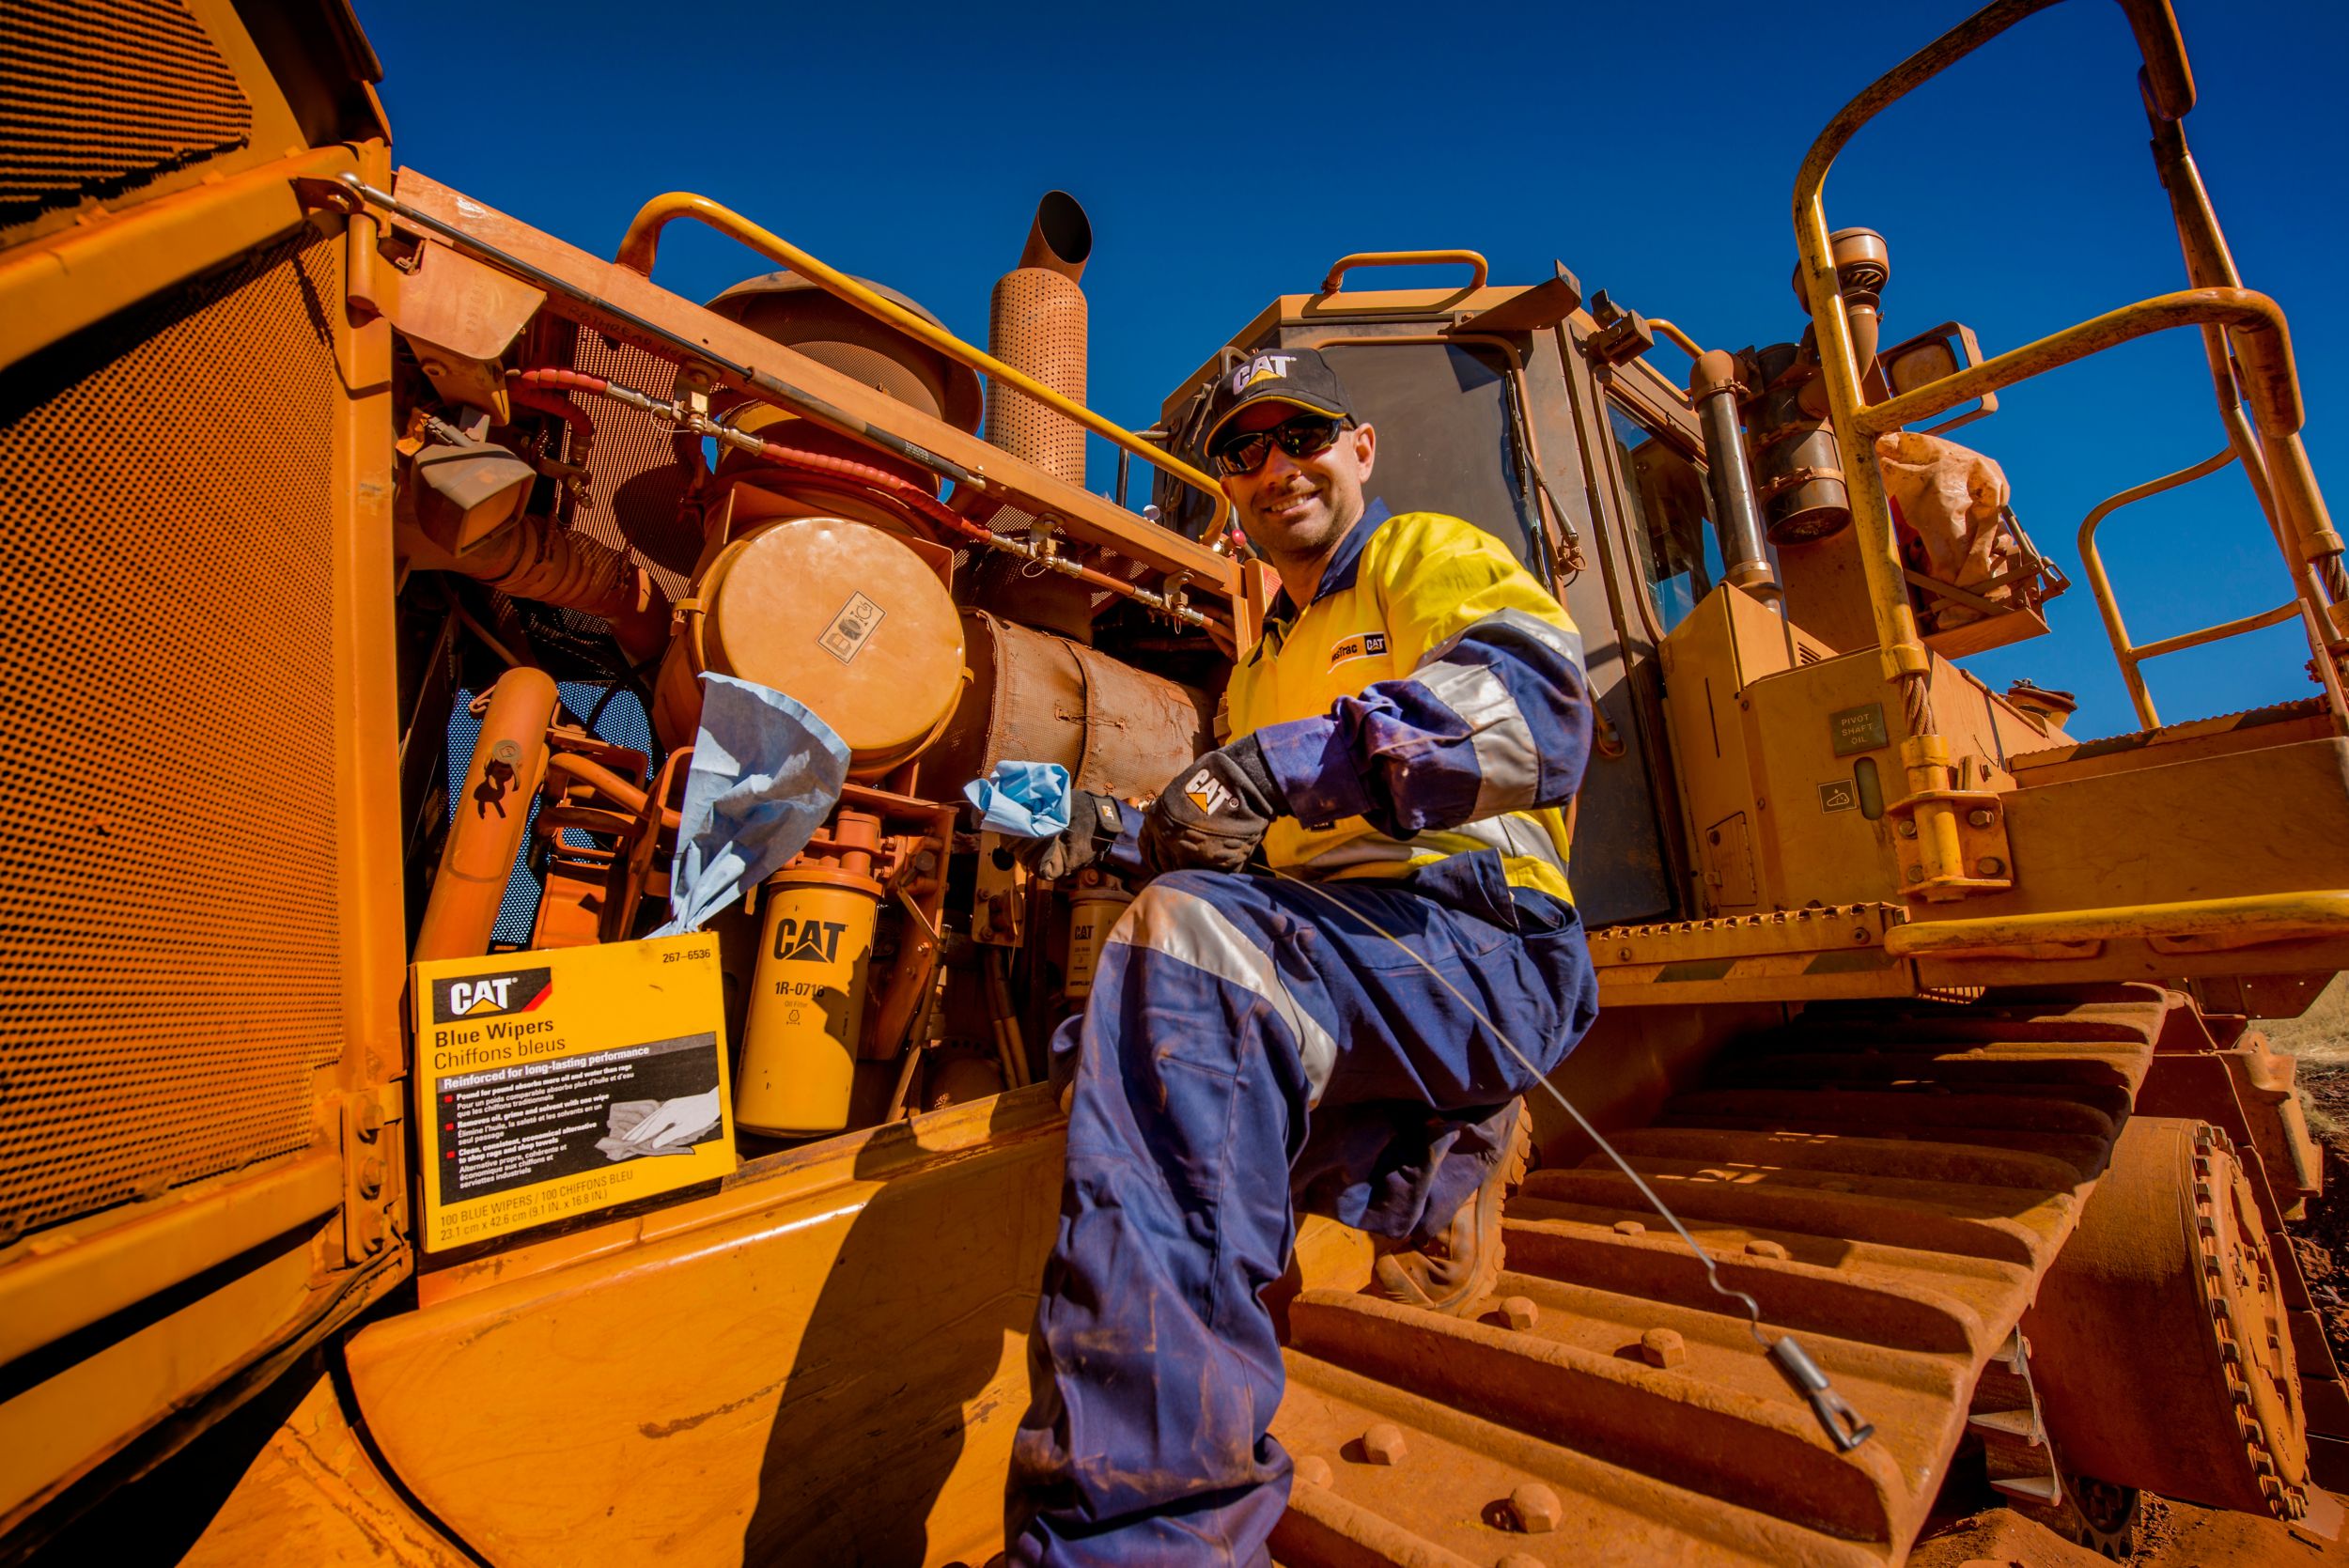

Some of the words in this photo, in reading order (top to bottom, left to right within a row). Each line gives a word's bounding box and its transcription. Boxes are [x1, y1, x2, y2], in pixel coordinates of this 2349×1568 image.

[1233, 355, 1290, 395] CAT
[1366, 639, 1384, 650] CAT
[1842, 713, 1869, 726] PIVOT
[1842, 723, 1873, 736] SHAFT
[1185, 768, 1232, 815] CAT
[773, 918, 847, 963] CAT
[1075, 924, 1094, 939] CAT
[662, 949, 711, 963] 267-6536
[450, 978, 512, 1016] CAT
[436, 1030, 480, 1048] Blue
[487, 1020, 553, 1040] Wipers
[435, 1047, 512, 1070] Chiffons
[518, 1038, 566, 1056] bleus
[444, 1070, 506, 1089] Reinforced
[507, 1068, 523, 1079] for
[525, 1057, 586, 1076] long-lasting
[588, 1047, 650, 1066] performance
[457, 1090, 479, 1100] Pound
[492, 1085, 514, 1096] pound
[515, 1079, 542, 1090] absorbs
[542, 1077, 560, 1085] more
[584, 1069, 602, 1078] water
[457, 1102, 474, 1110] Pour
[486, 1095, 505, 1105] poids
[506, 1088, 546, 1101] comparable
[547, 1082, 573, 1094] absorbe
[574, 1079, 587, 1089] plus
[458, 1118, 490, 1128] Removes
[504, 1111, 523, 1121] grime
[525, 1107, 537, 1115] and
[538, 1103, 563, 1112] solvent
[564, 1099, 579, 1108] with
[593, 1094, 610, 1102] wipe
[484, 1103, 511, 1112] chiffons
[512, 1094, 554, 1107] traditionnels
[517, 1116, 537, 1126] saleté
[557, 1109, 583, 1118] solvants
[459, 1136, 474, 1145] seul
[474, 1131, 505, 1143] passage
[521, 1128, 561, 1142] economical
[563, 1122, 597, 1134] alternative
[468, 1154, 485, 1162] shop
[487, 1150, 503, 1158] rags
[504, 1145, 517, 1154] and
[536, 1138, 559, 1147] towels
[518, 1157, 545, 1167] chiffons
[459, 1160, 498, 1173] Alternative
[459, 1176, 494, 1188] serviettes
[496, 1168, 532, 1180] industriels
[441, 1214, 458, 1226] 100
[461, 1205, 489, 1221] BLUE
[490, 1194, 532, 1213] WIPERS
[542, 1188, 557, 1202] 100
[560, 1176, 607, 1197] CHIFFONS
[610, 1170, 633, 1184] BLEU
[441, 1227, 459, 1241] 23.1
[464, 1224, 479, 1234] cm
[490, 1215, 508, 1226] 42.6
[512, 1211, 526, 1221] cm
[529, 1205, 544, 1218] (9.1
[548, 1201, 561, 1213] IN.
[572, 1194, 589, 1206] 16.8
[592, 1189, 607, 1201] IN.)
